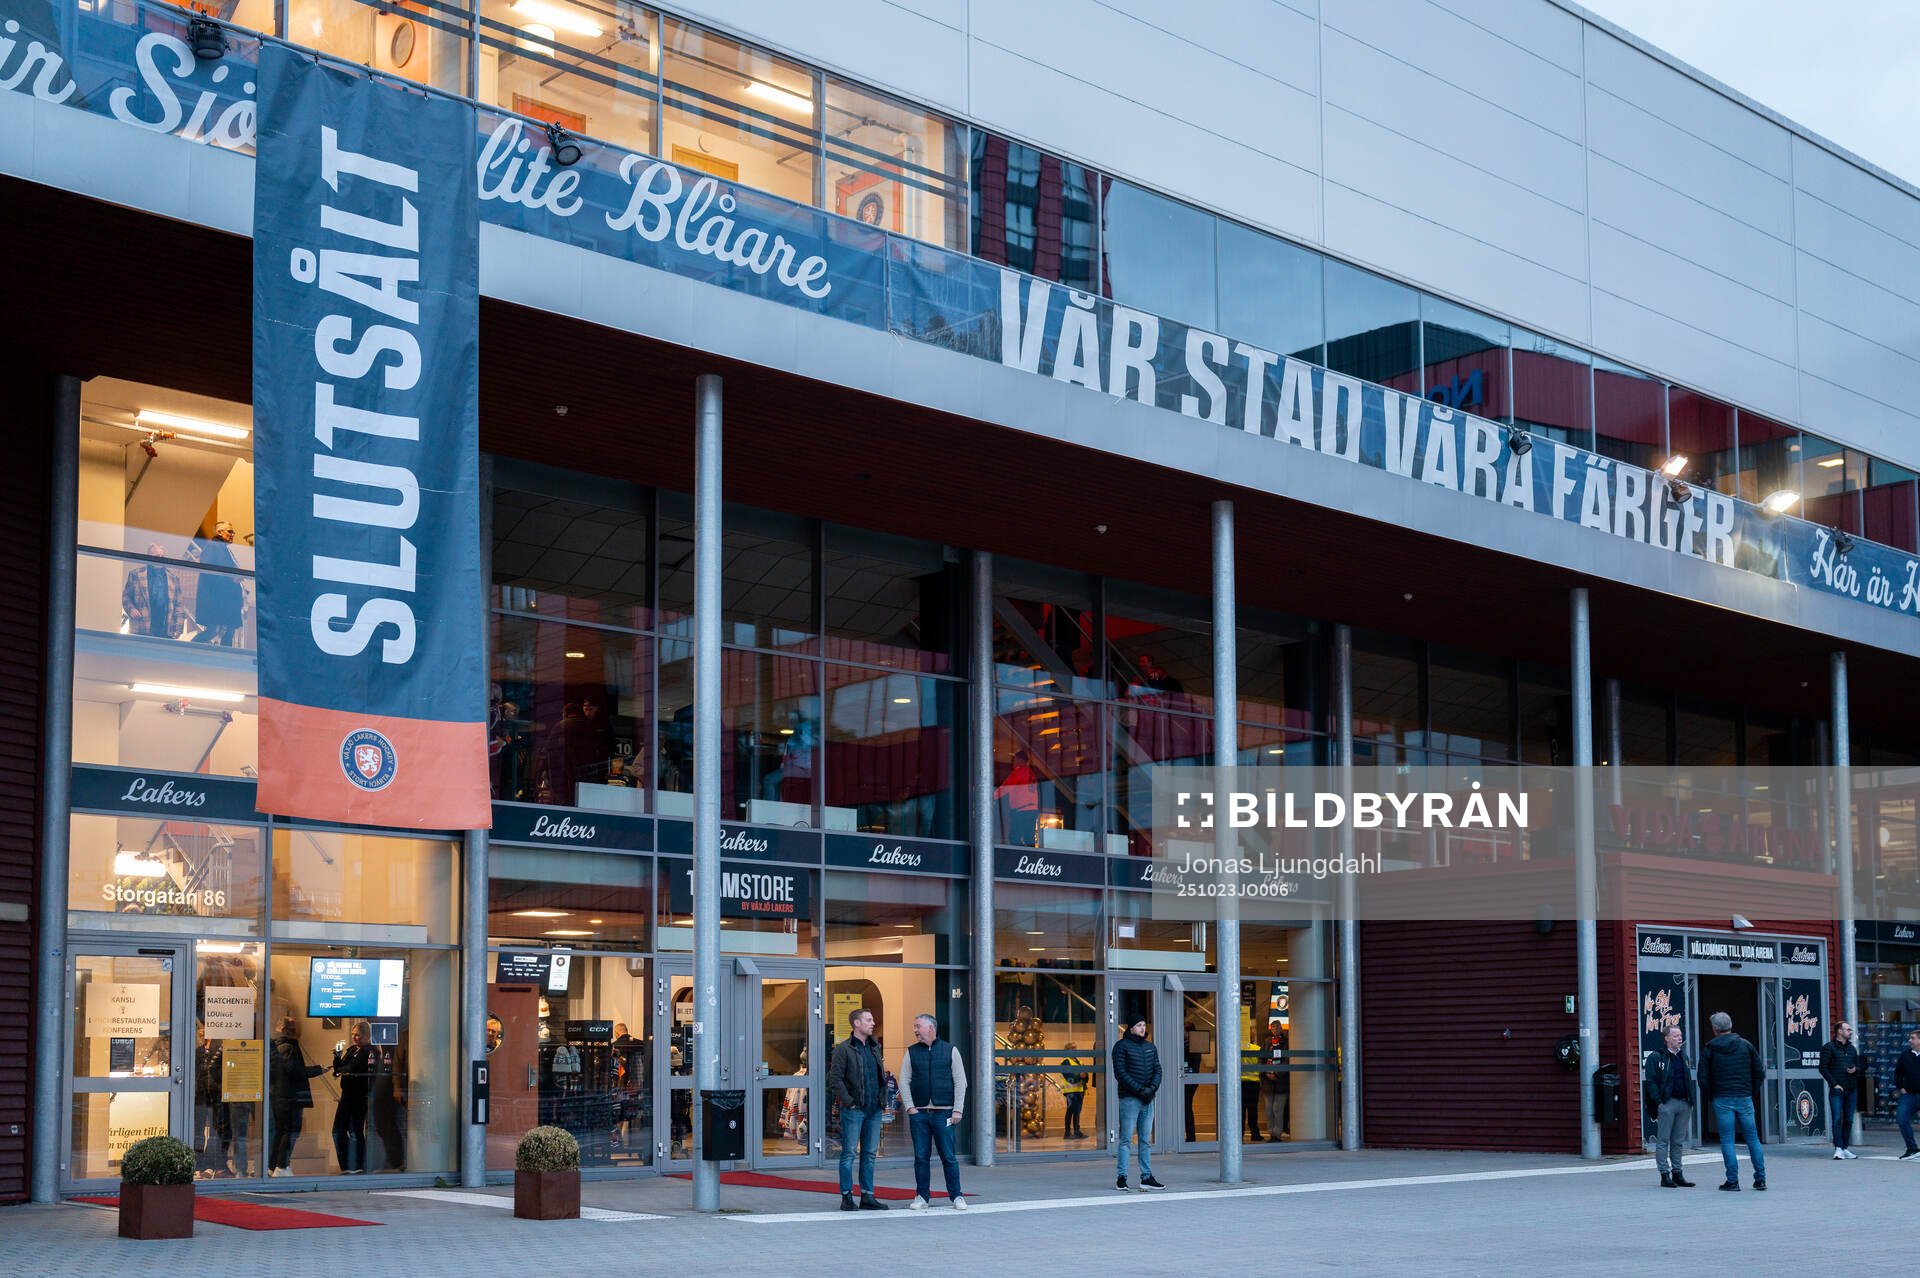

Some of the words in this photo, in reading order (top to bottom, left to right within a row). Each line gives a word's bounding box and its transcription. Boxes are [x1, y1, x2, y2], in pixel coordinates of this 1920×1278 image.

[605, 153, 832, 299] Blåare
[290, 124, 422, 664] SLUTSÅLT
[1000, 268, 1160, 407] VÅR
[1181, 327, 1363, 464] STAD
[1384, 389, 1535, 512] VÅRA
[1552, 443, 1736, 568] FÄRGER
[1866, 566, 1894, 607] är
[616, 743, 631, 755] 10
[121, 777, 206, 807] Lakers
[529, 815, 596, 839] Lakers
[1609, 803, 1695, 849] VIDA
[1727, 820, 1825, 864] ARENA
[868, 844, 921, 867] Lakers
[1014, 855, 1062, 877] Lakers
[686, 869, 794, 902] TMSTORE
[1141, 863, 1184, 885] Lakers
[102, 883, 197, 907] Storgatan
[203, 890, 226, 907] 86
[741, 901, 750, 911] BY
[751, 901, 771, 913] VÄXJÖ
[771, 904, 794, 914] LAKERS
[1641, 936, 1672, 954] Lakers
[1691, 940, 1728, 957] VÄLKOMMEN
[1728, 944, 1741, 958] TILL
[1741, 945, 1755, 958] VIDA
[1755, 946, 1774, 960] ARENA
[1791, 946, 1817, 963] Lakers
[143, 1126, 157, 1137] till
